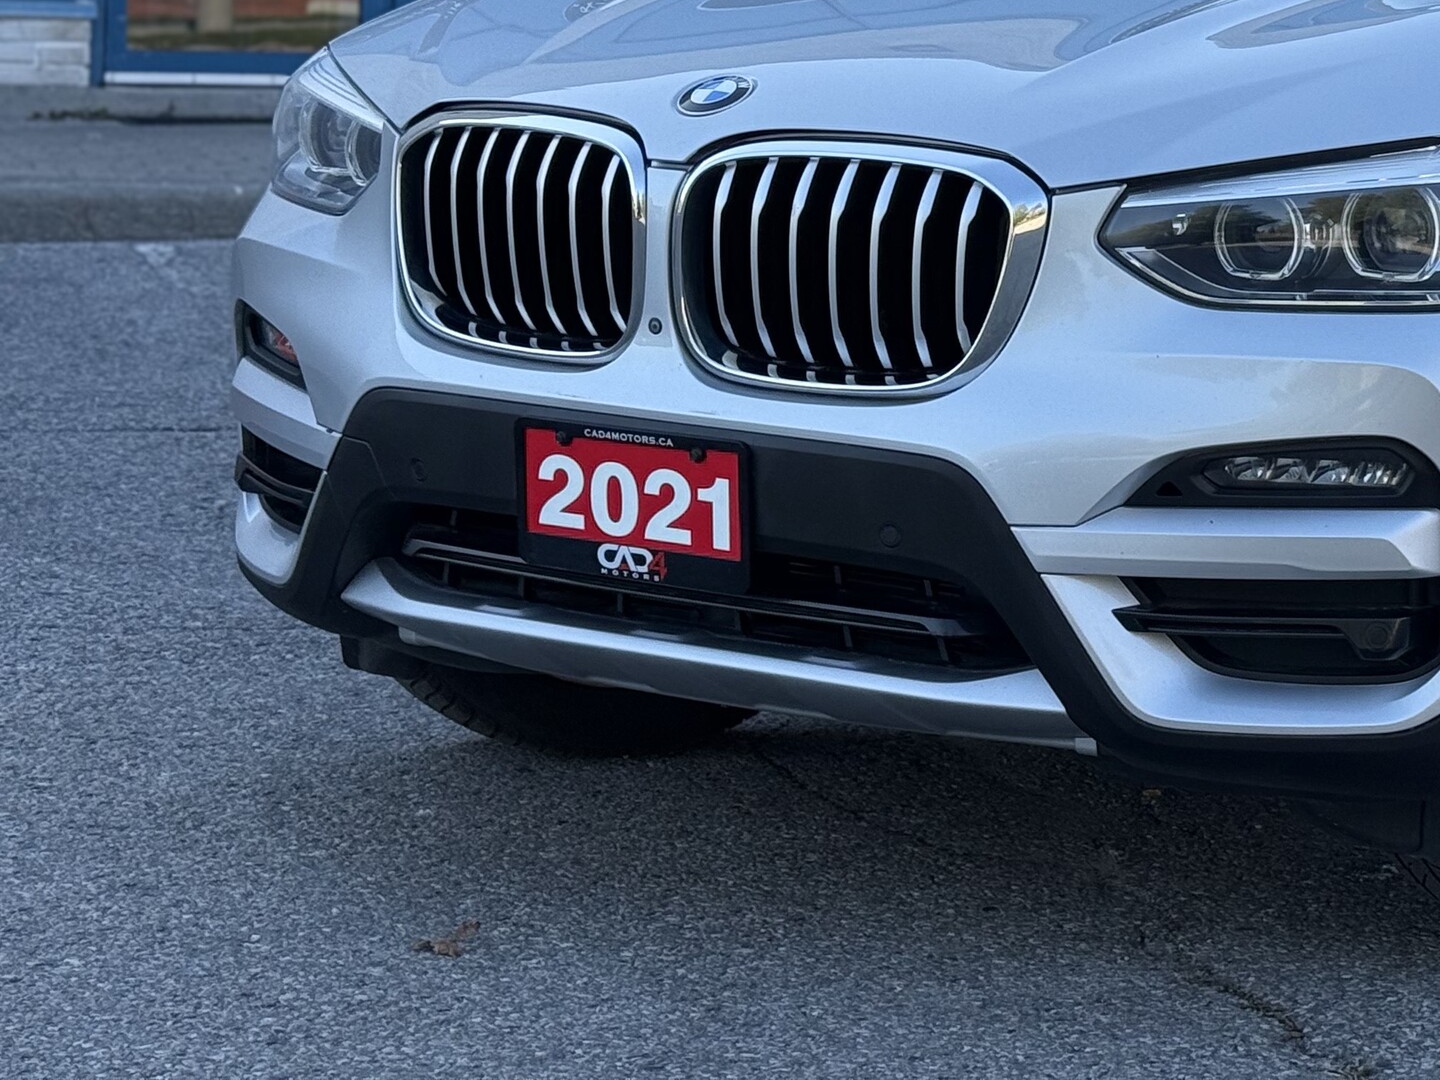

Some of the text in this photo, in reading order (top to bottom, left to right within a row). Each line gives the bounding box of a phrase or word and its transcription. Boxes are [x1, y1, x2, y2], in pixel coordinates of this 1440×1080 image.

[584, 428, 674, 447] CAD4MOTORS.CA
[538, 453, 731, 552] 2021
[601, 568, 660, 582] MOTORS
